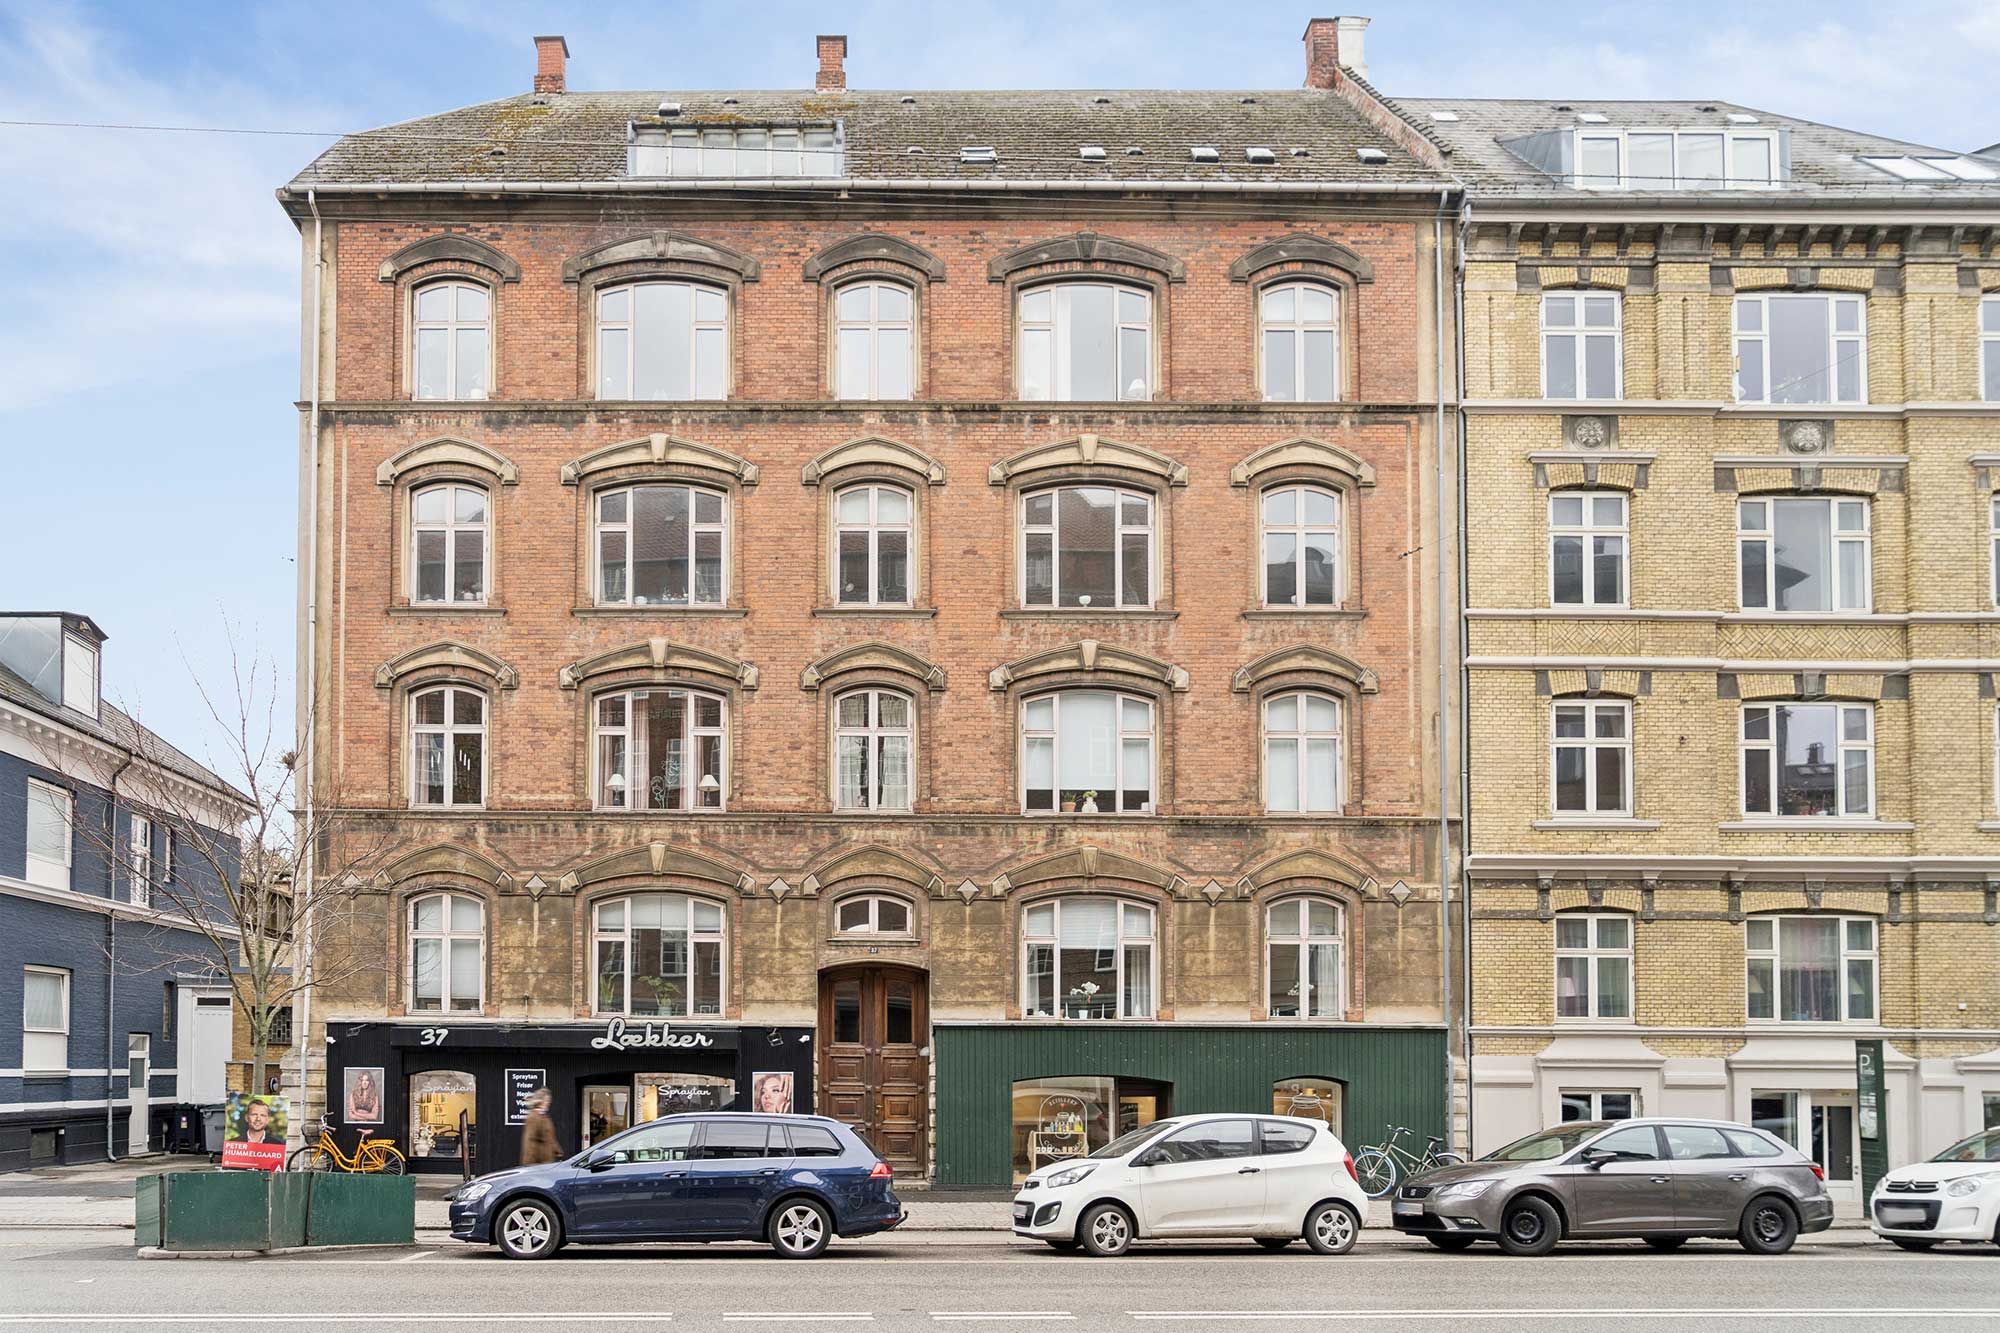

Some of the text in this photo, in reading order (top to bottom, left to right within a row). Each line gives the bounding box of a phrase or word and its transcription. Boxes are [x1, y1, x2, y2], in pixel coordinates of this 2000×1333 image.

[420, 1028, 449, 1047] 37
[591, 1016, 714, 1051] Lækker
[1860, 1054, 1871, 1075] P
[512, 1073, 538, 1081] Spraytan
[657, 1085, 711, 1100] Spraytan
[225, 1142, 248, 1150] PETER
[225, 1149, 282, 1159] HUMMELGAARD
